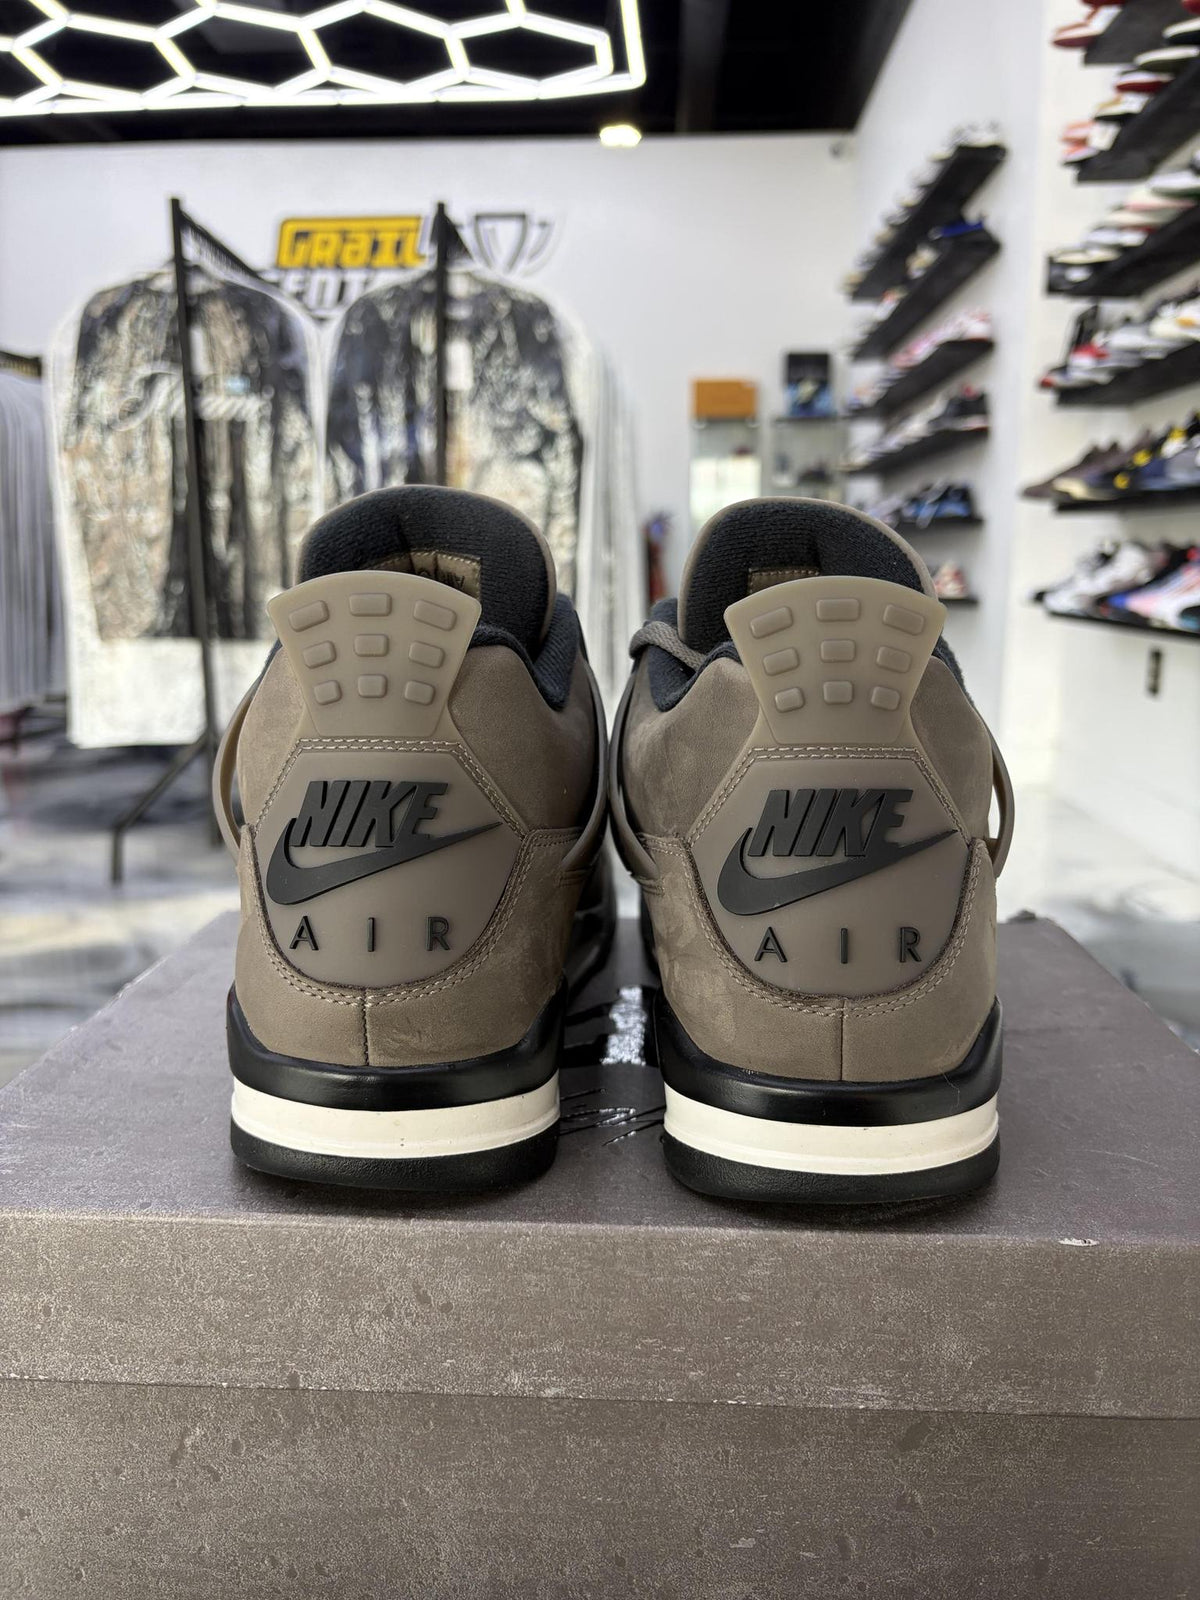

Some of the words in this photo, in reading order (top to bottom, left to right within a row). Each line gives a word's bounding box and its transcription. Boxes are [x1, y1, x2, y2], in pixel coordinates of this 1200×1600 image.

[289, 780, 448, 848] NIKE
[748, 788, 914, 857] NIKE
[289, 915, 450, 952] AIR
[754, 926, 922, 964] AIR
